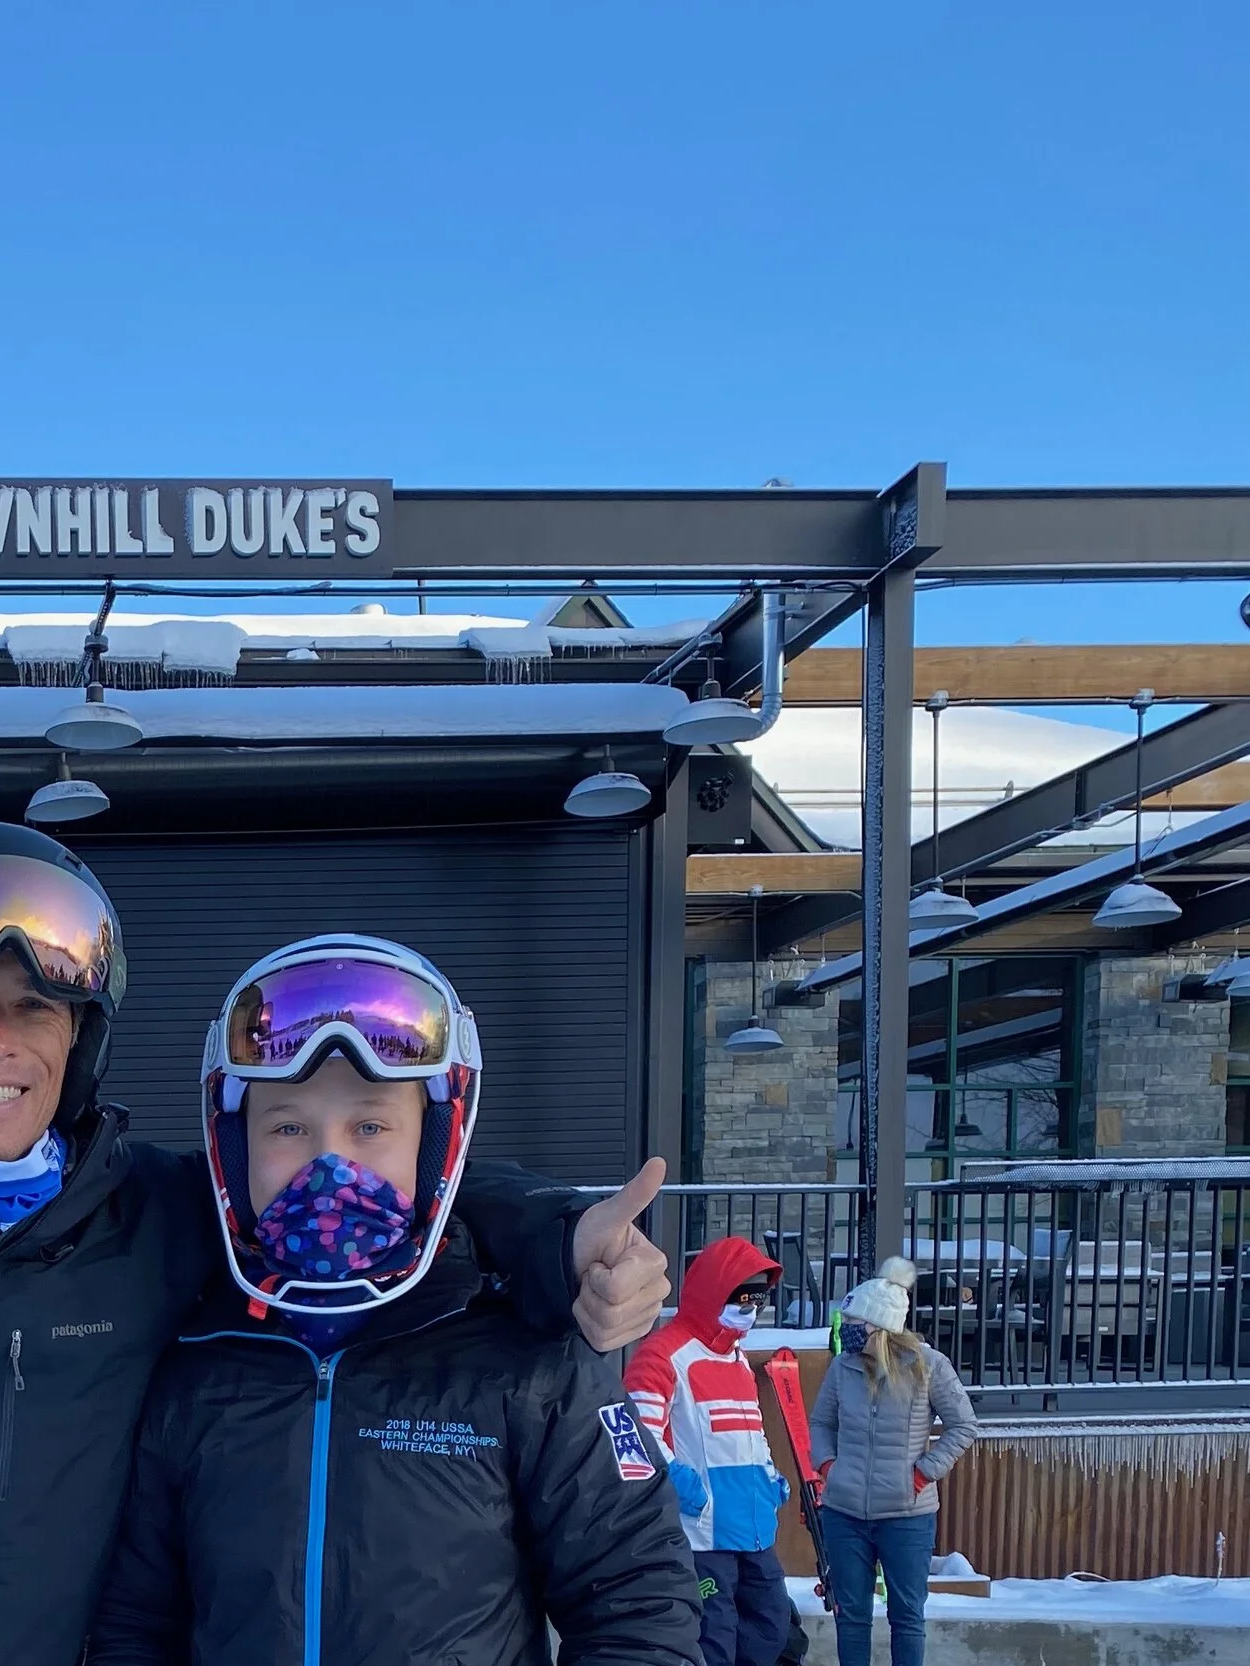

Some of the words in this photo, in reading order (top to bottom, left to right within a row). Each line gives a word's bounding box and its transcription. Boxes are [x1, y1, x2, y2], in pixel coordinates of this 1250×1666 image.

[190, 486, 382, 556] DUKE'S
[51, 1320, 113, 1339] patagonia
[386, 1419, 411, 1430] 2018
[416, 1420, 436, 1431] U14
[441, 1421, 474, 1434] USSA
[601, 1405, 634, 1435] US
[358, 1428, 408, 1440] EASTERN
[412, 1432, 498, 1447] CHAMPIONSHIPS
[380, 1440, 451, 1455] WHITEFACE,
